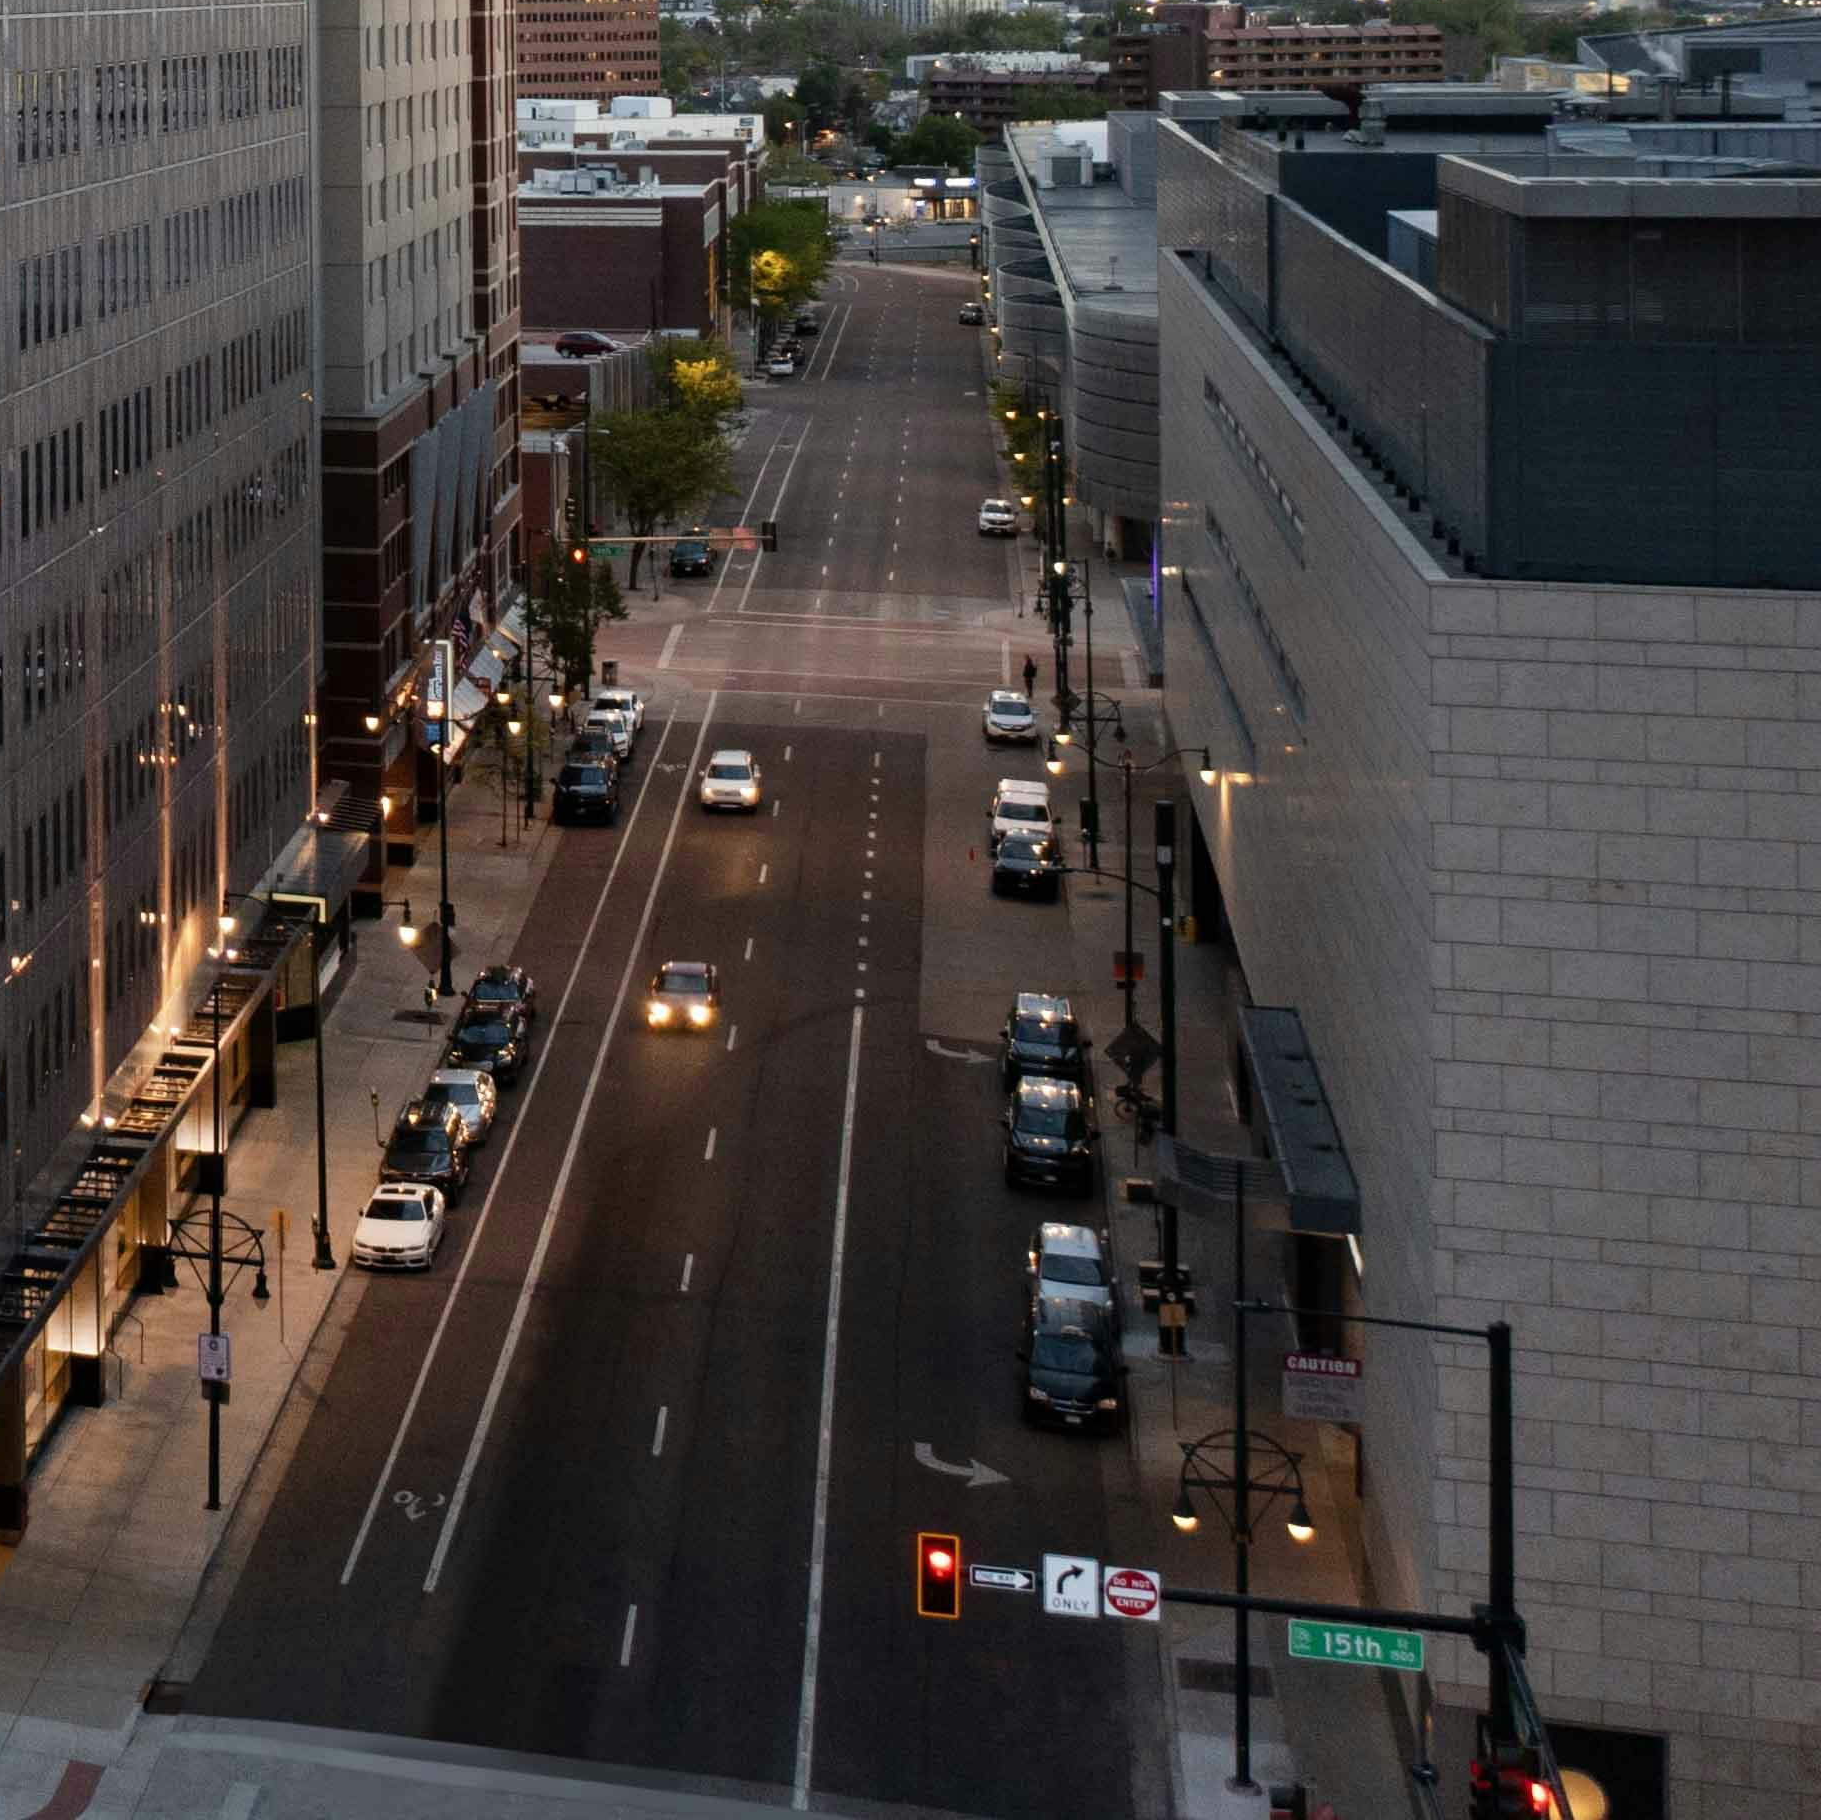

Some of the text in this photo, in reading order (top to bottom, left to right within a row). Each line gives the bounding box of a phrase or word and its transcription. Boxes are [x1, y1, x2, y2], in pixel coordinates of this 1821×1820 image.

[1287, 1355, 1356, 1375] CAUTION
[1113, 1577, 1151, 1590] DO NOT
[1052, 1597, 1090, 1611] ONLY
[1116, 1597, 1148, 1610] ENTER
[1323, 1631, 1382, 1660] 15th
